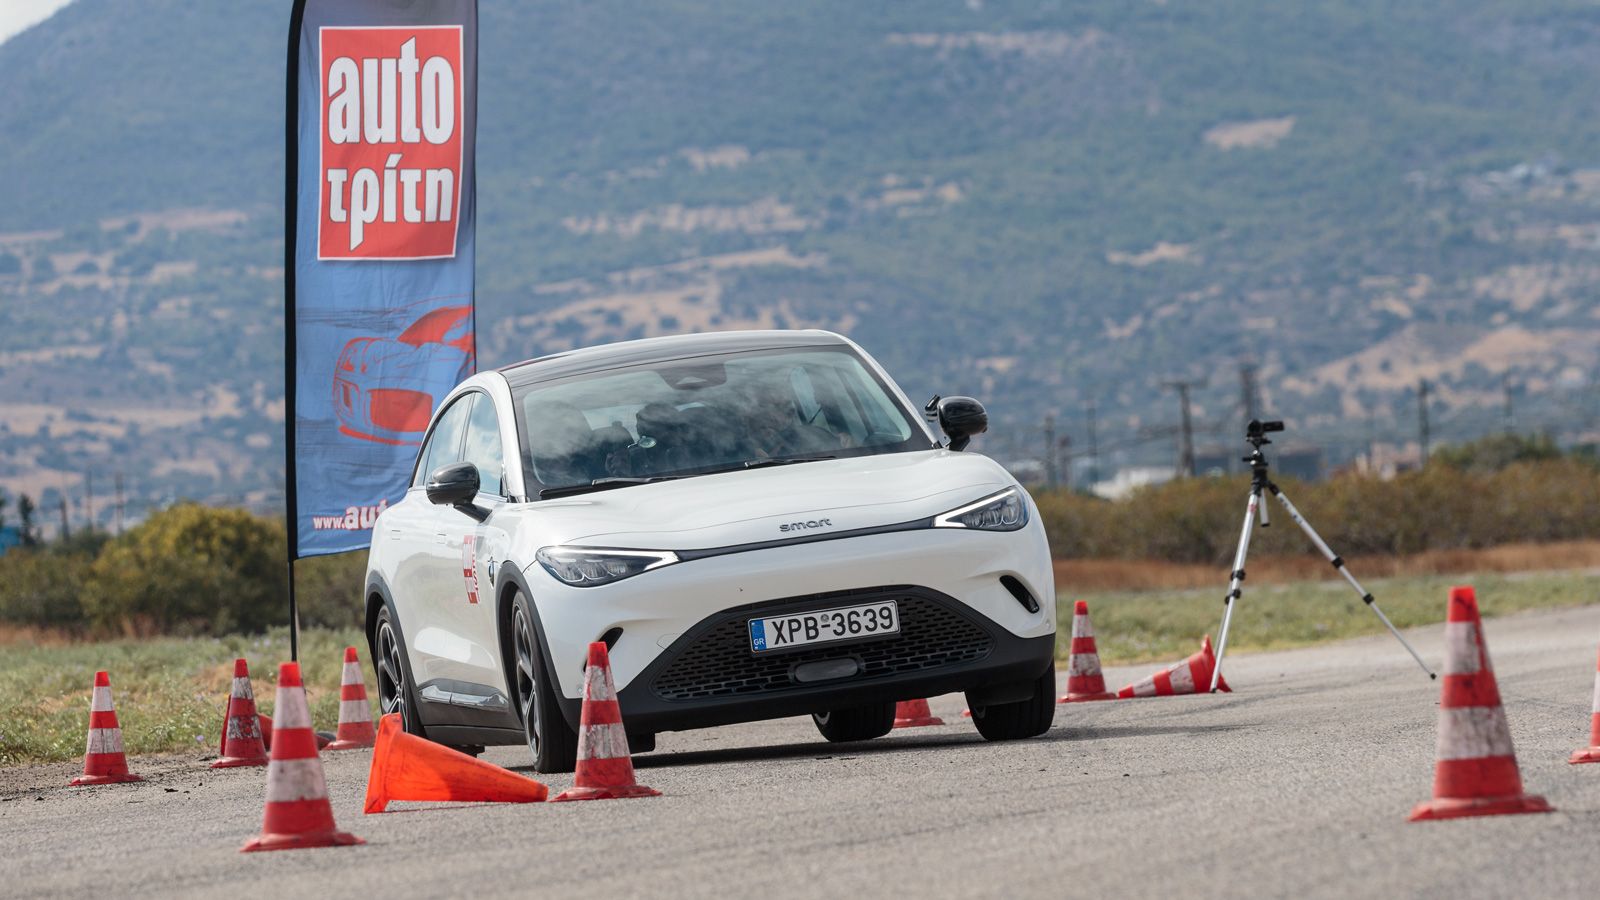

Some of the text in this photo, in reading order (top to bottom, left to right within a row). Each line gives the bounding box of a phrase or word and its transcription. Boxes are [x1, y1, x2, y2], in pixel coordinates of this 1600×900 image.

[328, 35, 455, 144] auto
[327, 153, 455, 251] τρίτη
[779, 518, 832, 532] smart
[753, 637, 765, 646] GR
[771, 606, 894, 645] XPB-3639
